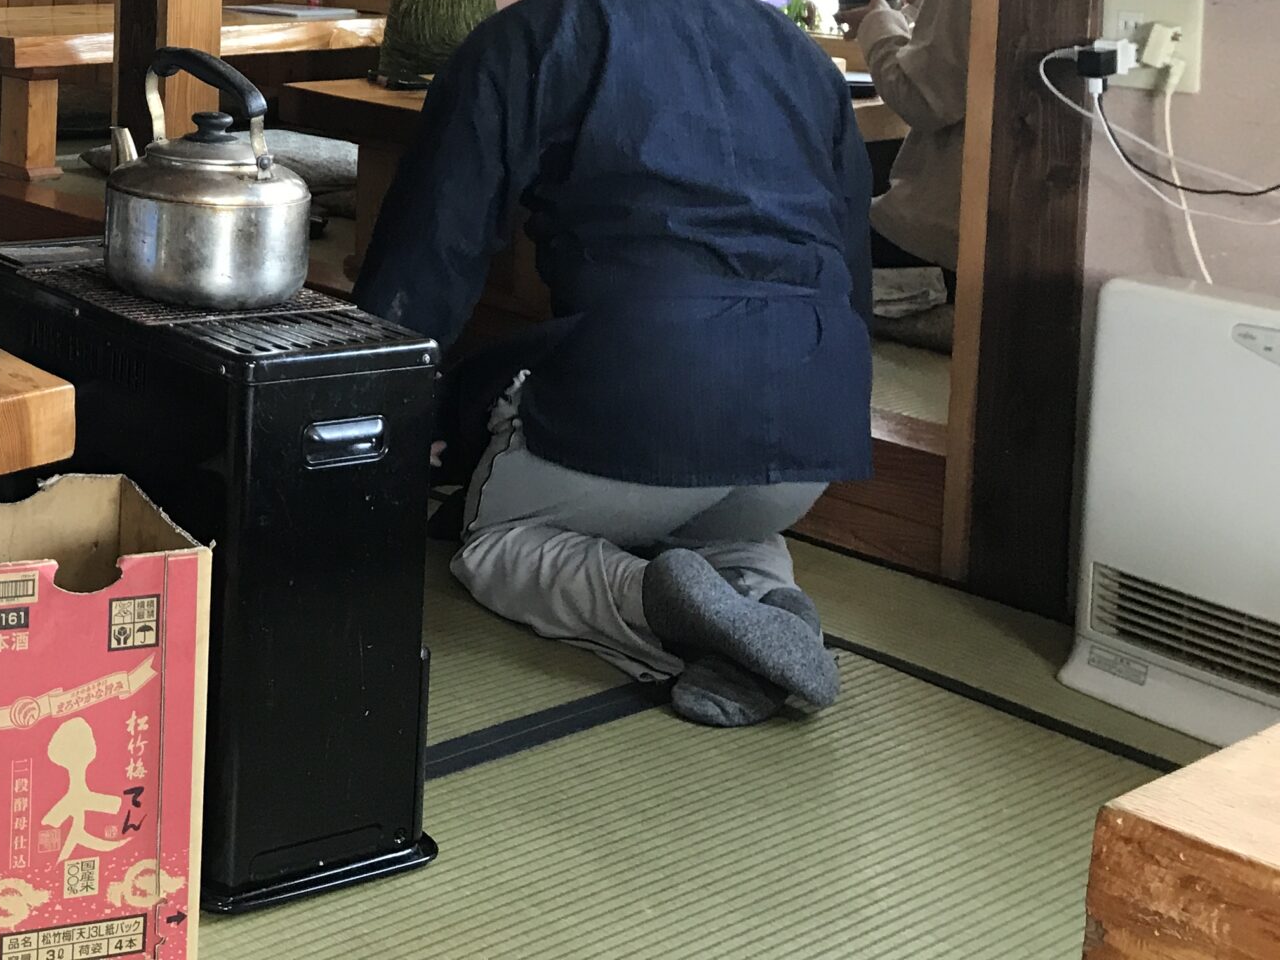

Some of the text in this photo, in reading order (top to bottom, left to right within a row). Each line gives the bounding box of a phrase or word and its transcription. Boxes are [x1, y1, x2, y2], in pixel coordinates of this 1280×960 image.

[124, 710, 150, 781] 松竹梅
[13, 759, 30, 868] 二段酵母仕込
[122, 786, 148, 835] てん
[80, 859, 96, 893] 国産米
[8, 936, 32, 949] 品名
[78, 941, 103, 955] 荷姿
[115, 937, 137, 950] 4本
